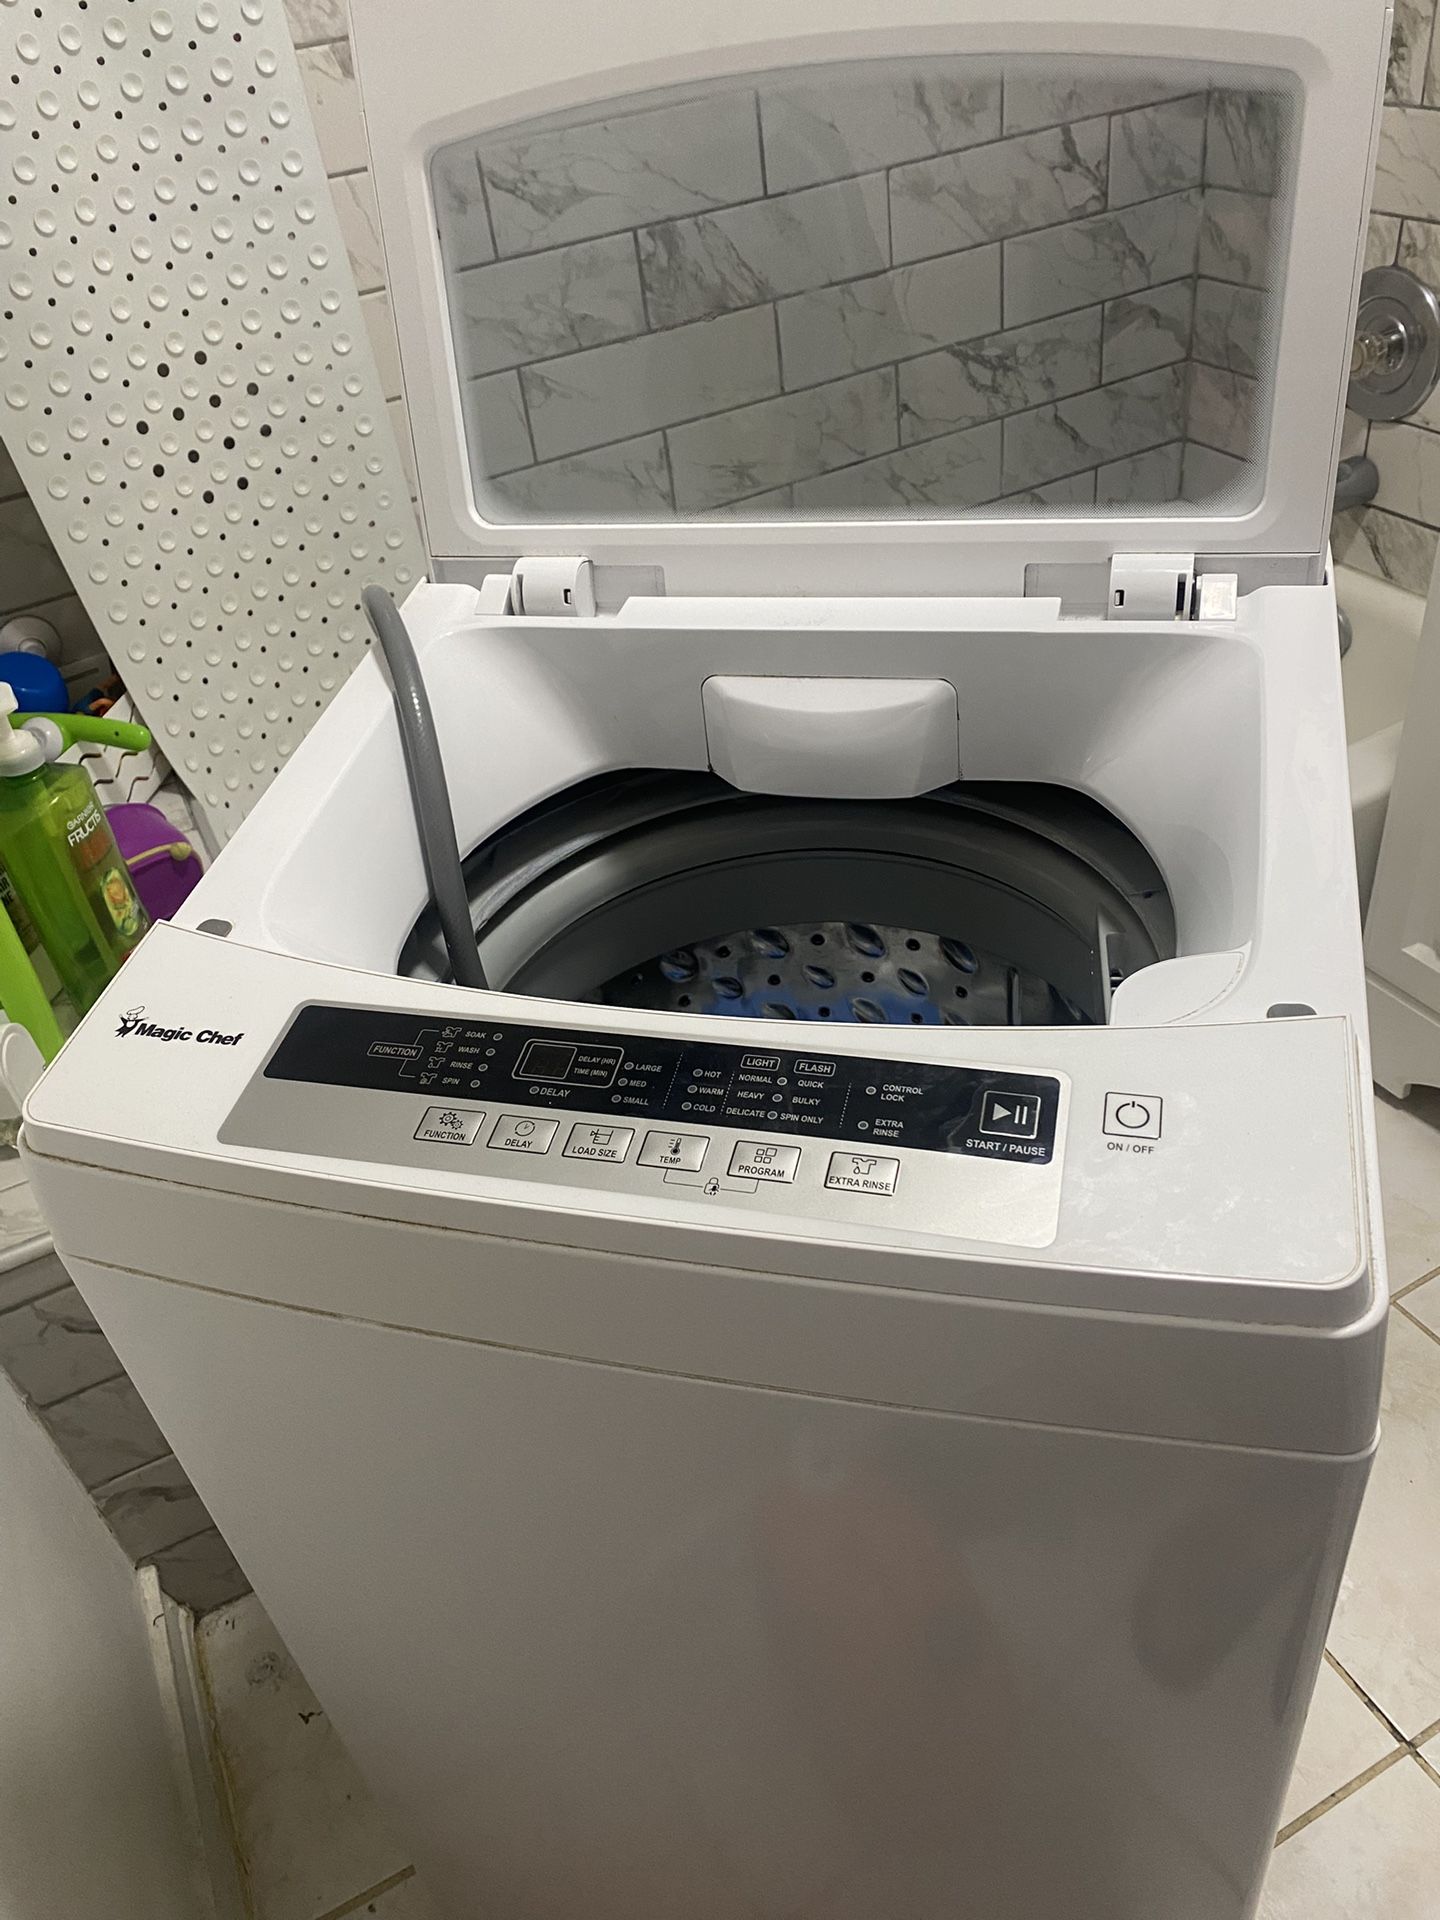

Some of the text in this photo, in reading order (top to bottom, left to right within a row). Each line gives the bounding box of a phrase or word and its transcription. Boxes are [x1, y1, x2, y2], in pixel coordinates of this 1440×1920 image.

[134, 1023, 245, 1046] Magic Chef
[465, 1030, 487, 1039] SOAK
[373, 1045, 418, 1057] FUNCTION
[458, 1045, 480, 1054] WASH
[450, 1060, 474, 1070] RINSE
[578, 1055, 616, 1066] DELAY (HR)
[746, 1058, 776, 1068] LIGHT
[574, 1067, 608, 1078] TIME (MIN)
[635, 1063, 662, 1073] LARGE
[799, 1063, 831, 1073] FLASH
[704, 1070, 721, 1079] HOT
[738, 1074, 773, 1084] NORMAL
[442, 1076, 460, 1086] SPIN
[629, 1080, 647, 1088] MED
[798, 1080, 824, 1089] QUICK
[540, 1088, 571, 1098] DELAY
[699, 1087, 724, 1096] WARM
[883, 1084, 924, 1095] CONTROL
[737, 1091, 765, 1100] HEAVY
[881, 1093, 905, 1102] LOCK
[623, 1096, 649, 1106] SMALL
[792, 1096, 821, 1106] BULKY
[693, 1103, 716, 1113] COLD
[726, 1107, 766, 1118] DELICATE
[780, 1112, 824, 1124] SPIN ONLY
[875, 1118, 904, 1129] EXTRA
[424, 1129, 466, 1141] FUNCTION
[873, 1128, 900, 1138] RINSE
[504, 1138, 533, 1148] DELAY
[966, 1138, 1046, 1157] START / PAUSE
[572, 1146, 618, 1158] LOAD SIZE
[1107, 1142, 1124, 1152] ON
[1133, 1144, 1155, 1155] OFF
[659, 1155, 682, 1165] TEMP
[738, 1165, 785, 1178] PROGRAM
[829, 1175, 892, 1191] EXTRA RINSE
